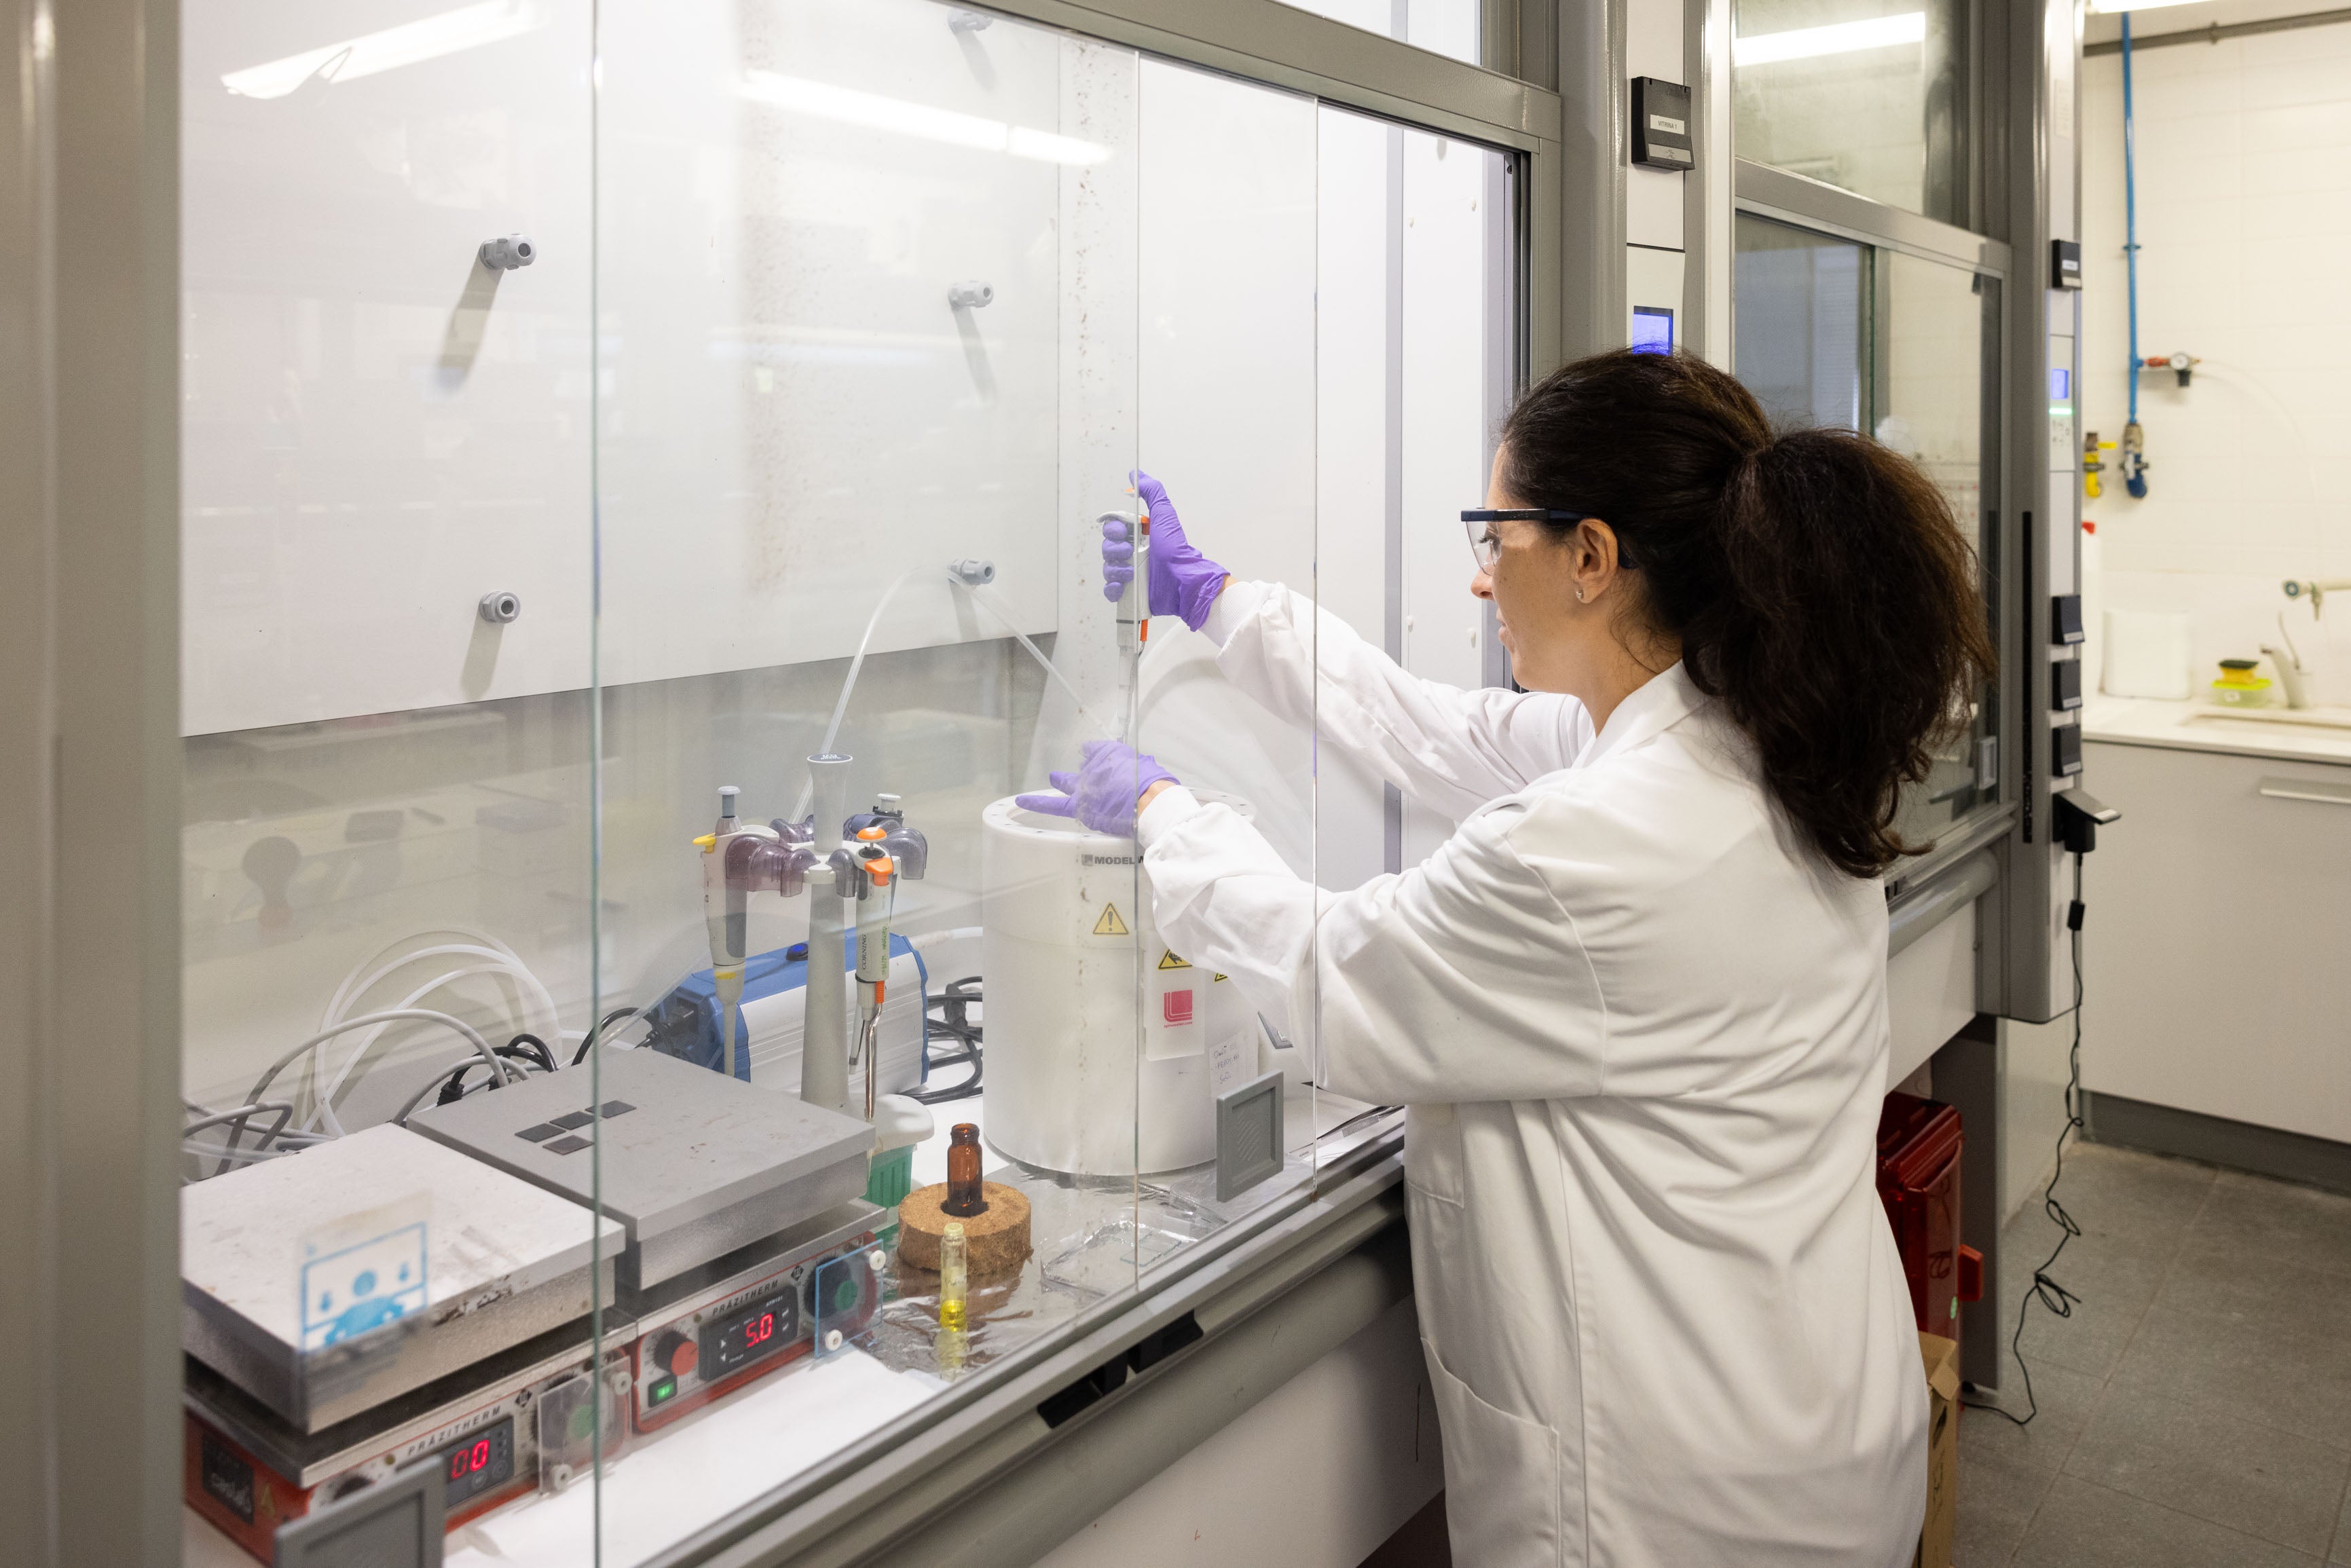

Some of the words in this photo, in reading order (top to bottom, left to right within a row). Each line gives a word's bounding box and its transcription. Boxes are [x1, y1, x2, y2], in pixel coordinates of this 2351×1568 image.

[1658, 121, 1674, 129] VITRINA
[1094, 856, 1135, 865] MODEL
[745, 1313, 773, 1348] 5.0
